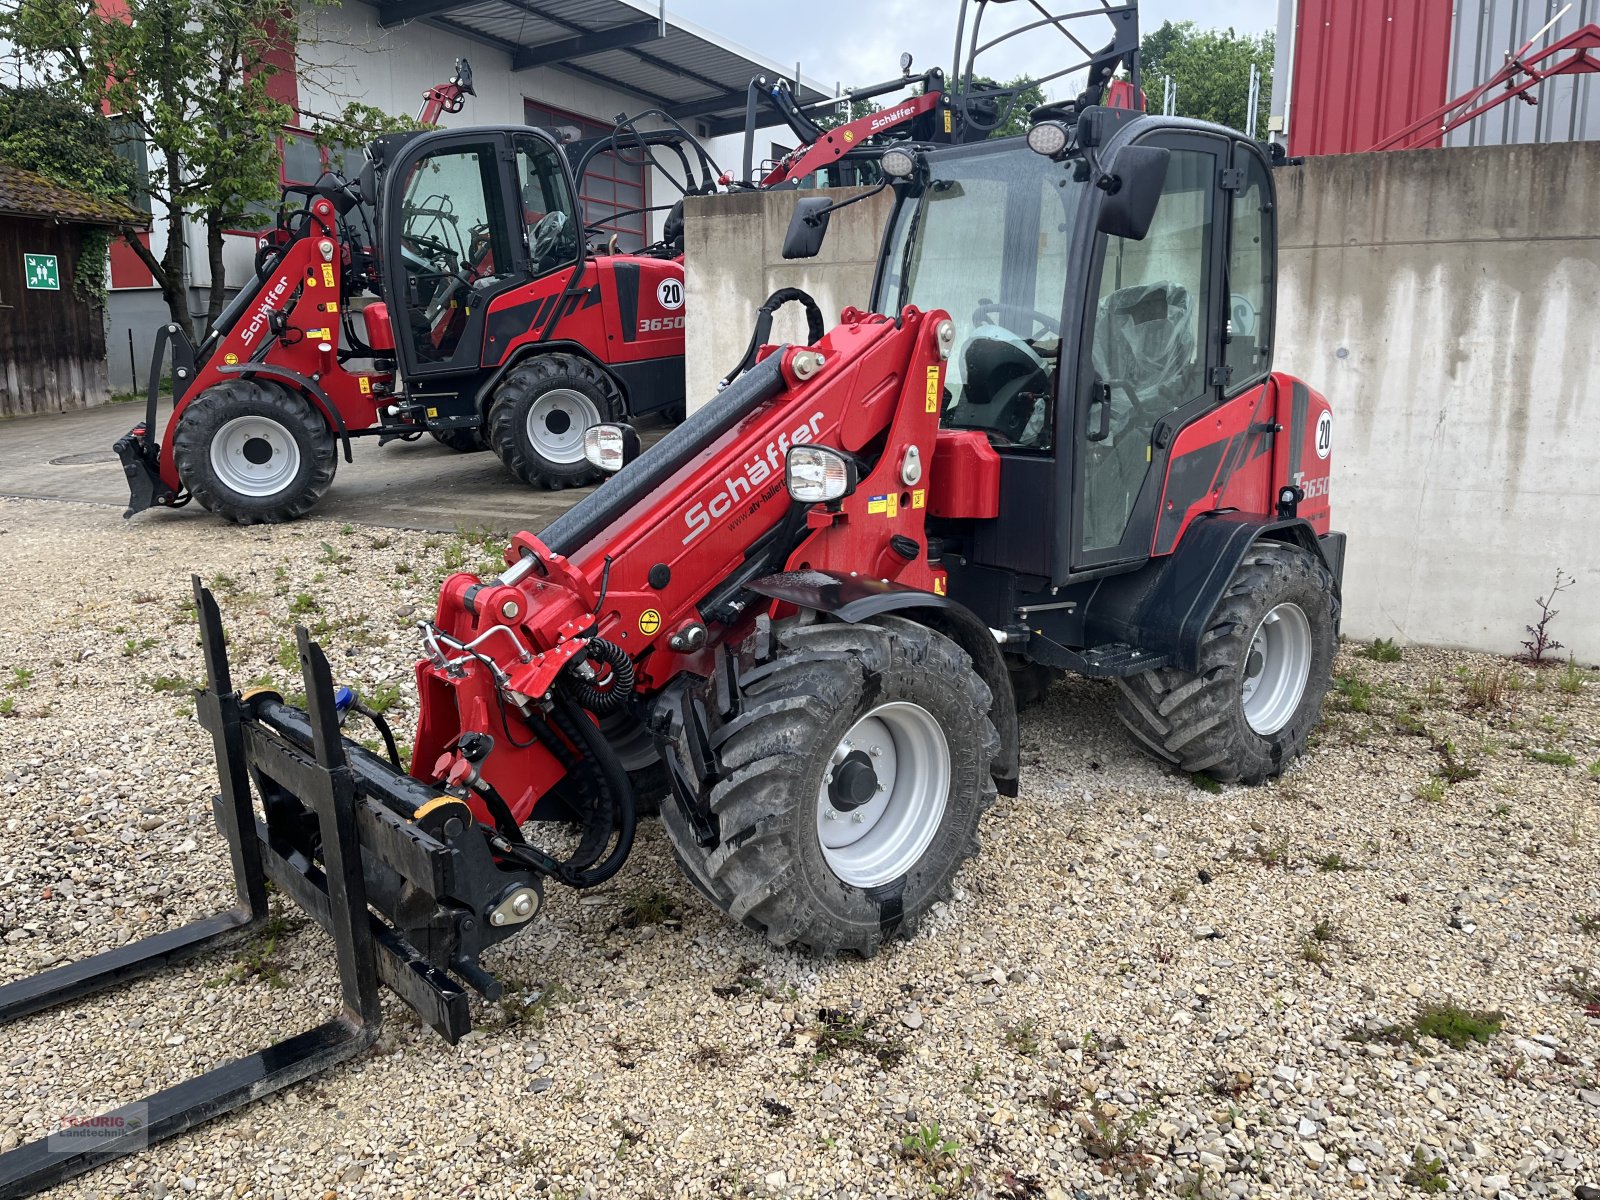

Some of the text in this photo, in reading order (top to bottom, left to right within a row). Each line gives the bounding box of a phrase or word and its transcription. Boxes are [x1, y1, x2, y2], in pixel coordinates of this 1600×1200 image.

[870, 105, 915, 130] Schäffer
[663, 284, 681, 304] 20
[638, 316, 685, 332] 3650
[1318, 419, 1331, 450] 20
[682, 411, 825, 545] Schäffer
